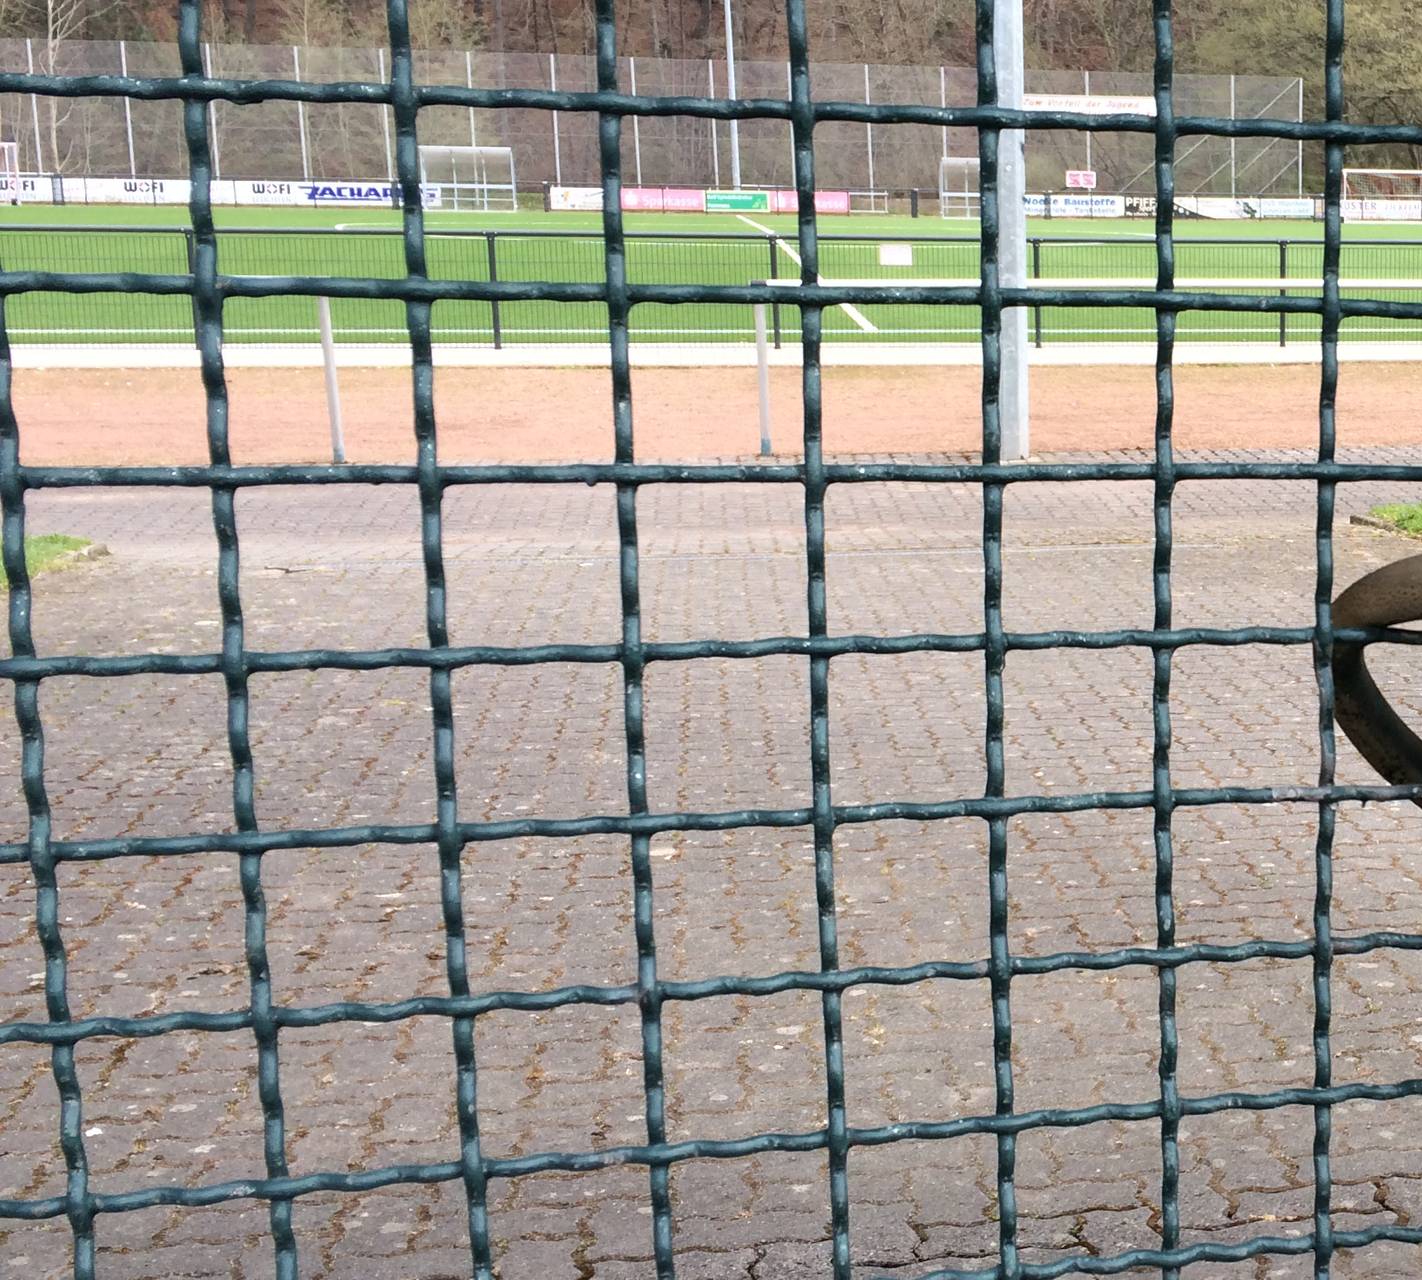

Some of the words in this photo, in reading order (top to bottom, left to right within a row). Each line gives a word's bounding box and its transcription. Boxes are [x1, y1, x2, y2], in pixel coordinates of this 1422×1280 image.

[124, 182, 164, 193] WOFI
[252, 183, 291, 194] WOFI
[643, 195, 698, 209] Sparkasse
[1063, 197, 1116, 206] Baustoffe
